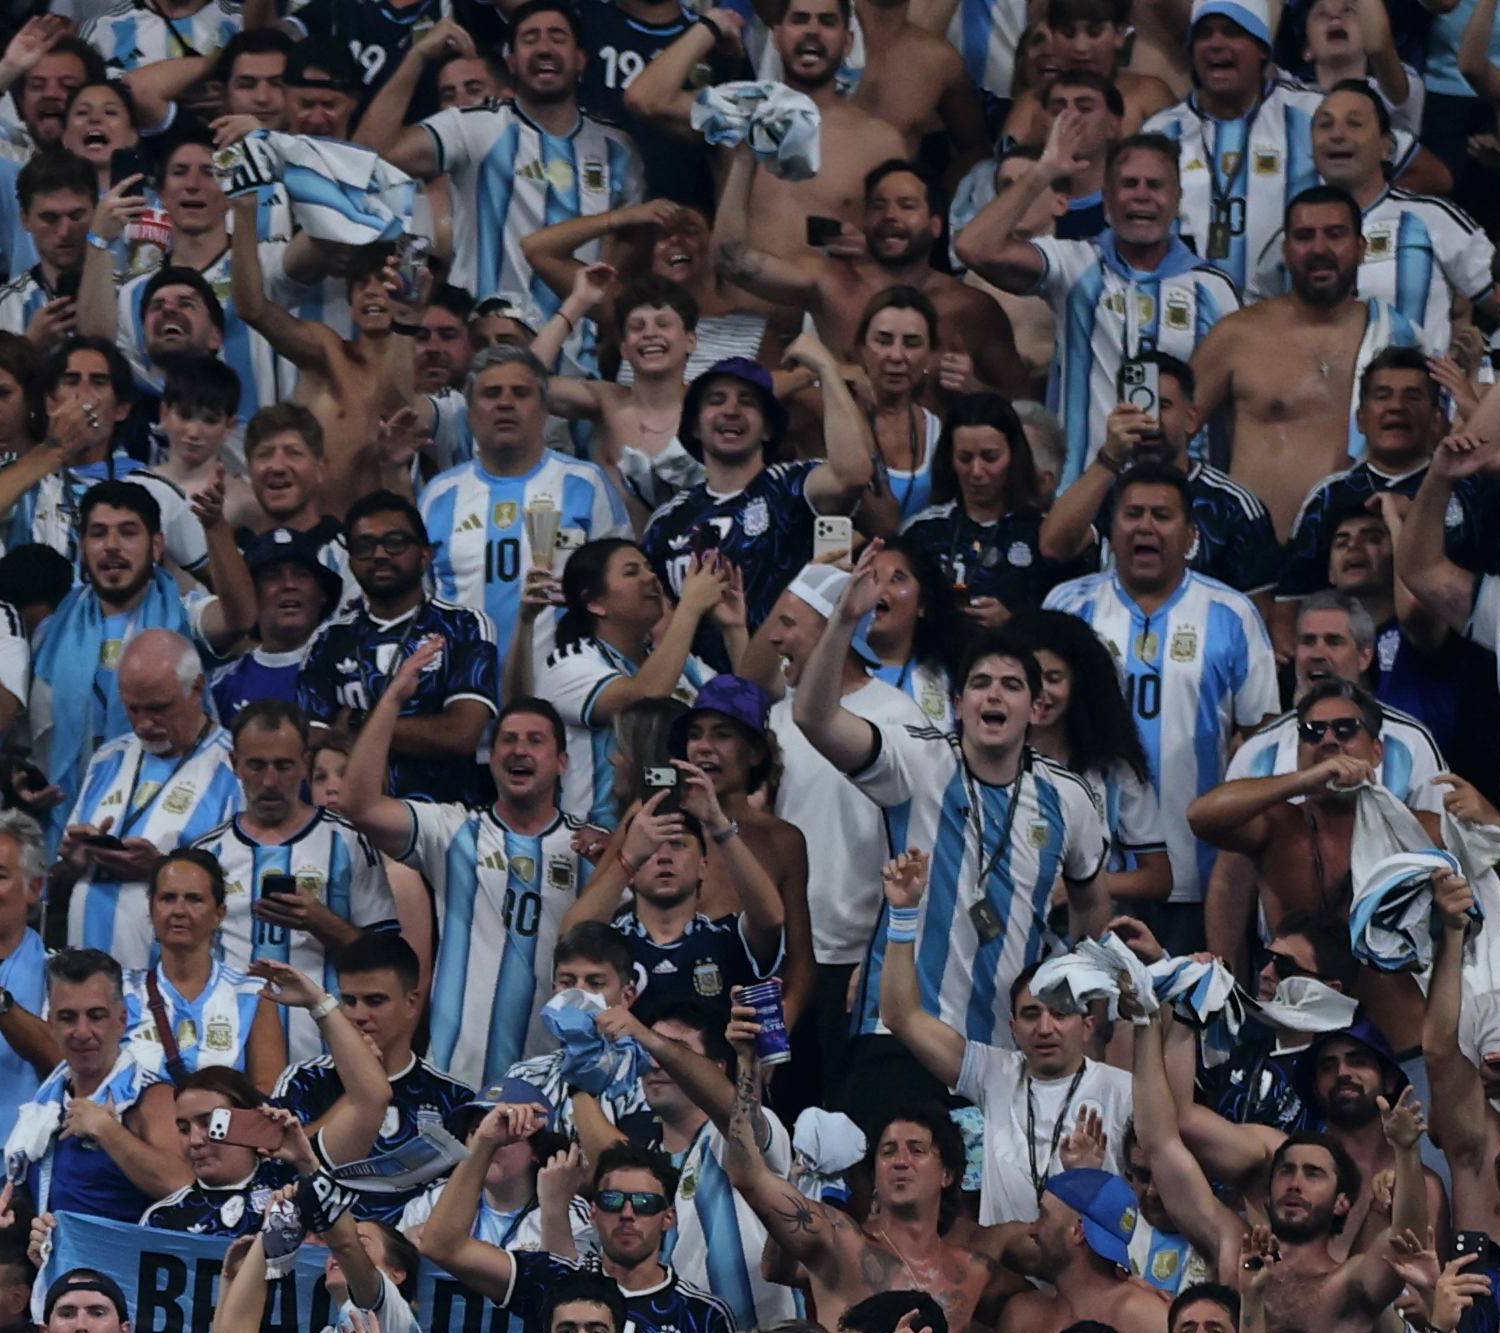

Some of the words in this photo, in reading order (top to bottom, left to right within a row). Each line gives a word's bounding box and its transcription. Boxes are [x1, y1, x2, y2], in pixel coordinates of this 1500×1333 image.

[599, 46, 646, 89] 19
[486, 538, 520, 583] 10
[1130, 676, 1162, 720] 10
